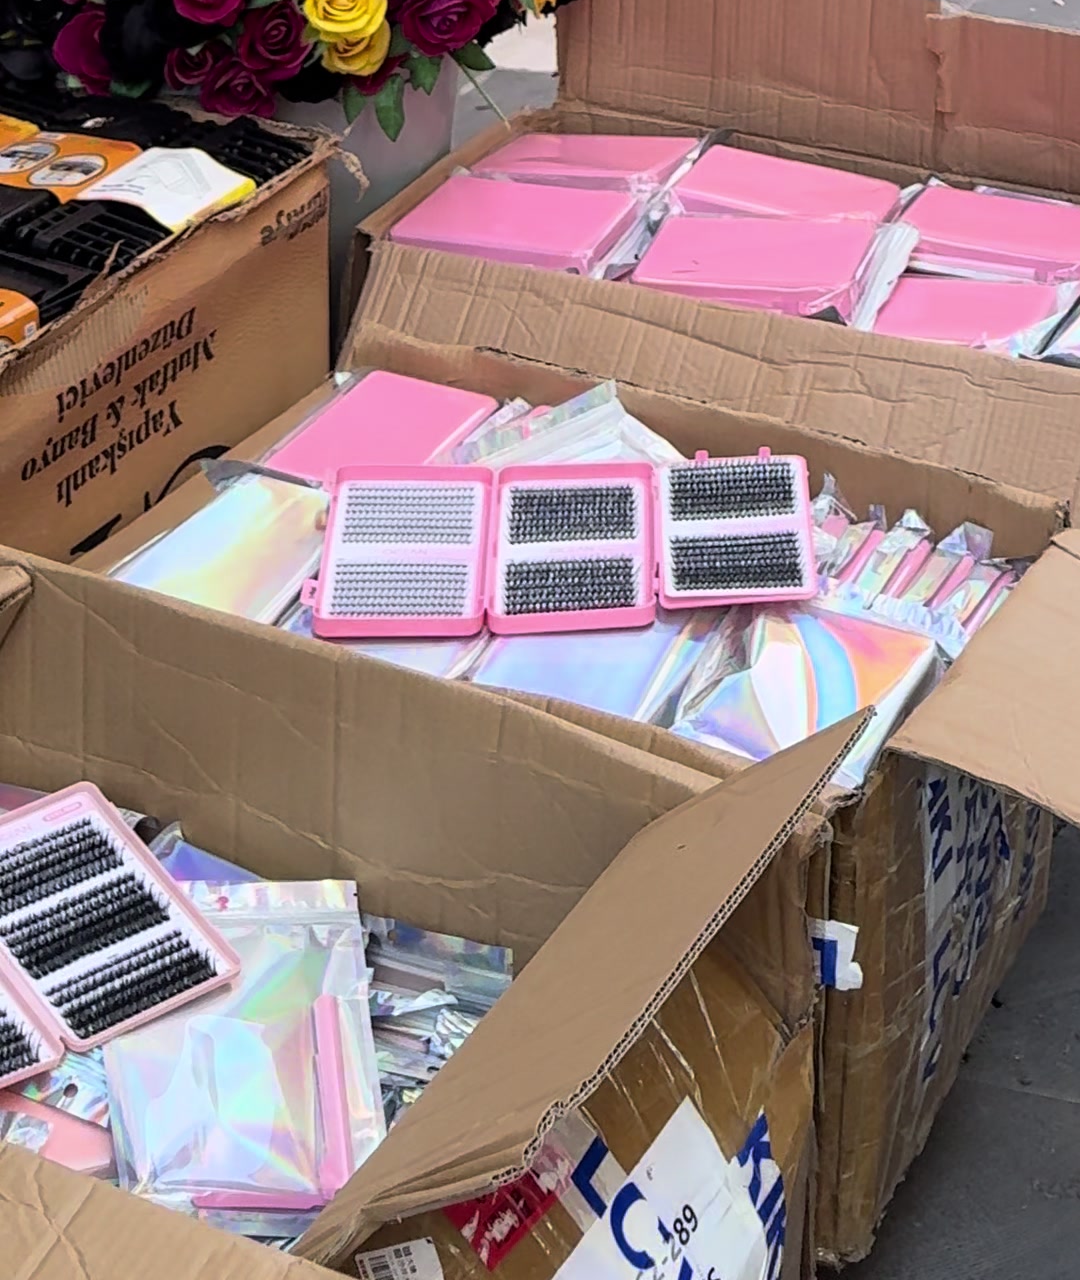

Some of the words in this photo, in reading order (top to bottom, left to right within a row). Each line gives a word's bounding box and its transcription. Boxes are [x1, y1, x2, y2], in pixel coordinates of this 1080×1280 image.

[56, 306, 197, 424] Düzenleyici
[131, 329, 218, 410] Mutfak
[21, 413, 99, 481] Banyo
[106, 395, 125, 428] &
[56, 399, 184, 508] Yapışkanlı
